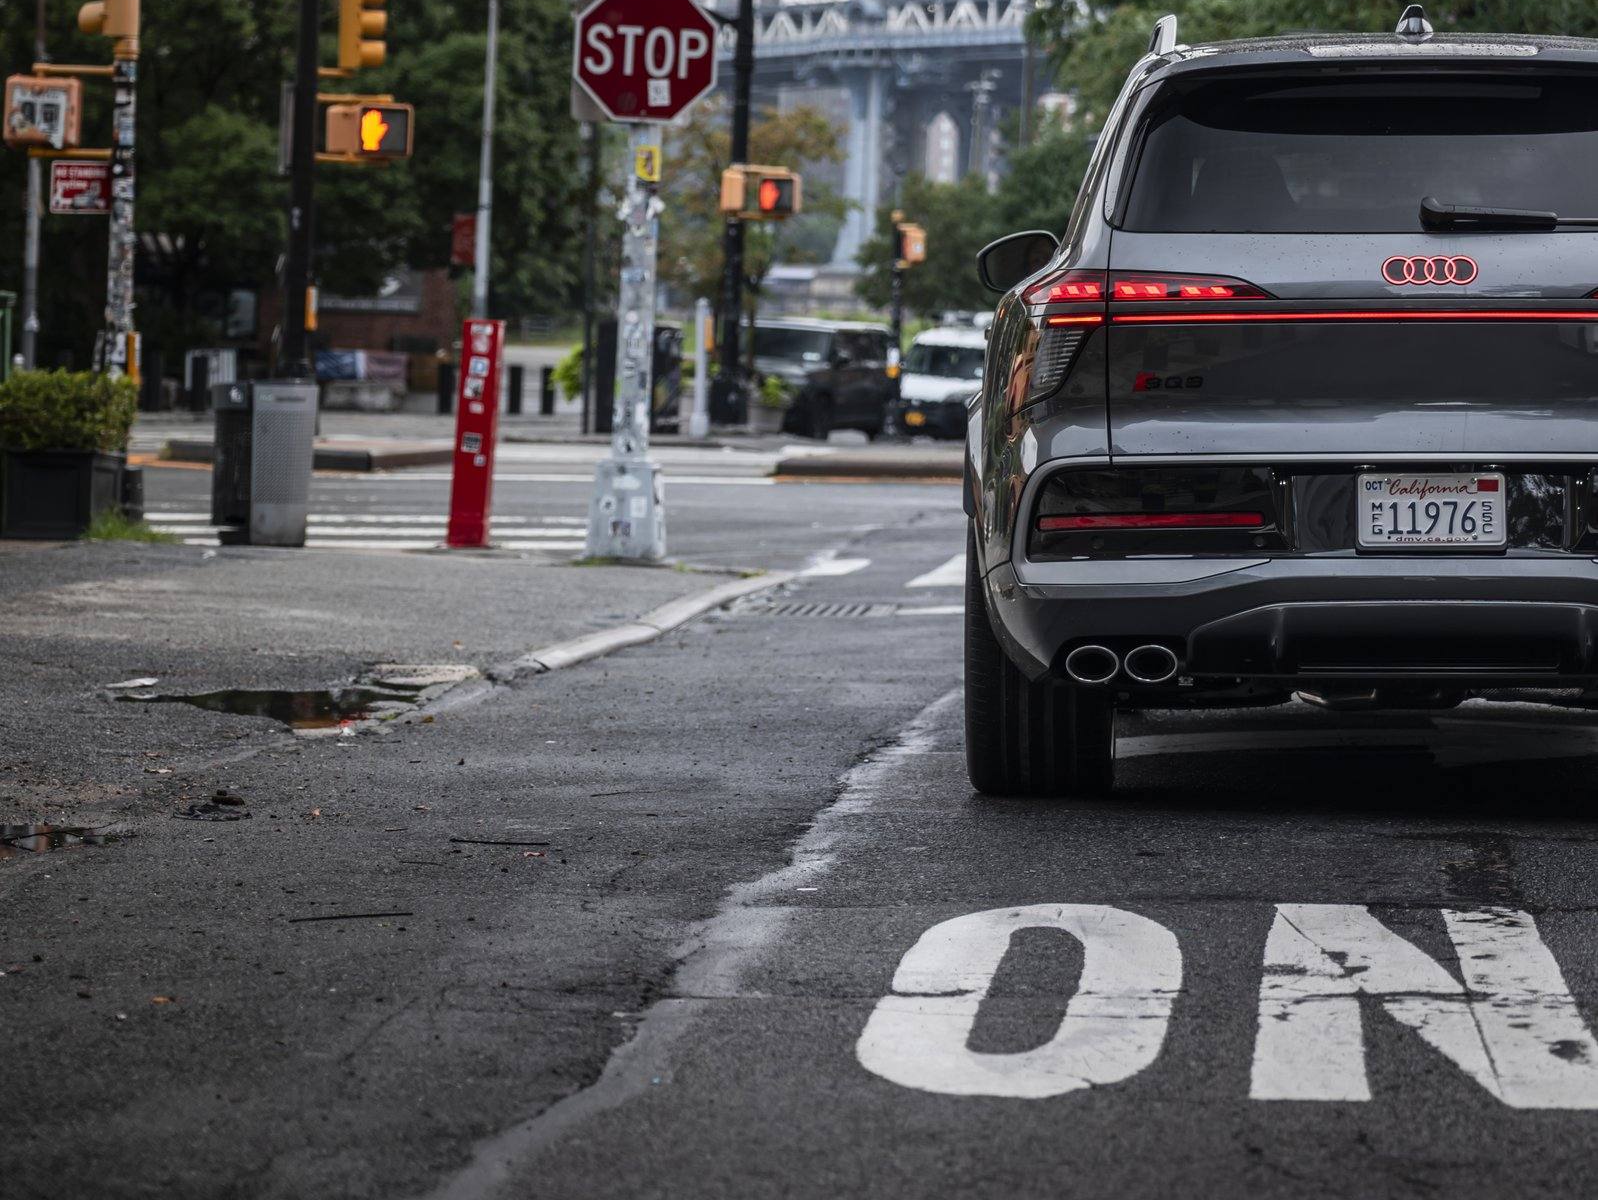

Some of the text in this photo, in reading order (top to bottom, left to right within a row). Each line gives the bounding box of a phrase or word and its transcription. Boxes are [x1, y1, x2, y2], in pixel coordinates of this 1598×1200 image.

[584, 22, 709, 80] STOP
[1365, 481, 1382, 491] OCT
[1389, 479, 1478, 500] California
[1388, 501, 1476, 535] 11976
[856, 903, 1598, 1110] ON
